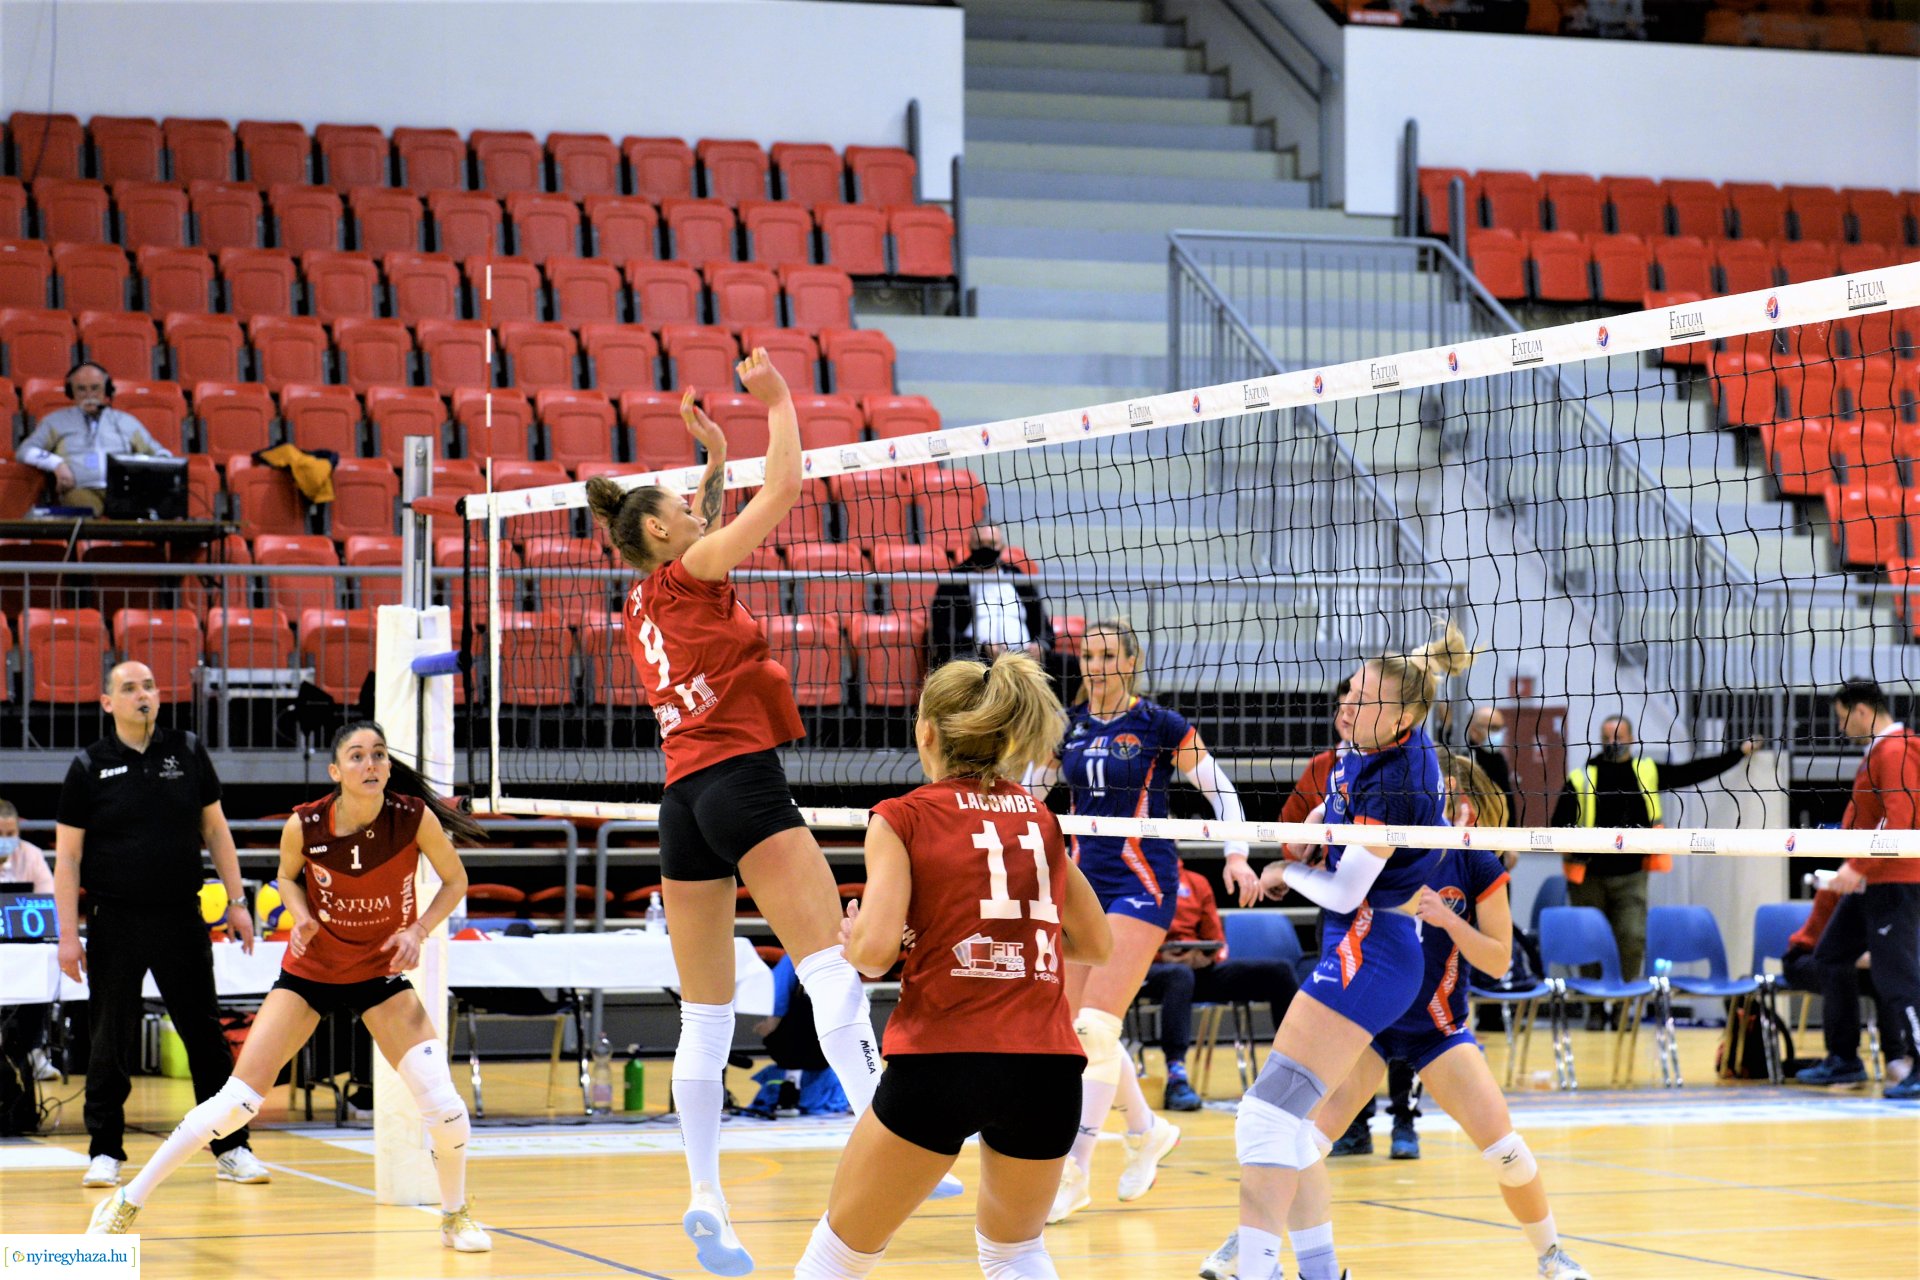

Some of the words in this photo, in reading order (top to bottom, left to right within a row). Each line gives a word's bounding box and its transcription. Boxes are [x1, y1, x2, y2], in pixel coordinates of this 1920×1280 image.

[1847, 280, 1885, 299] FATUM
[1669, 311, 1704, 329] FATUM
[1512, 338, 1543, 356] FATUM
[1370, 363, 1399, 380] FATUM
[1243, 384, 1269, 401] FATUM
[638, 614, 670, 691] 9
[1086, 758, 1105, 797] 11
[955, 792, 1037, 813] LACOMBE
[1530, 831, 1552, 845] FATUM
[351, 845, 362, 869] 1
[971, 819, 1060, 923] 11
[319, 888, 391, 910] FATUM
[22, 908, 45, 937] 0
[991, 942, 1023, 956] FIT
